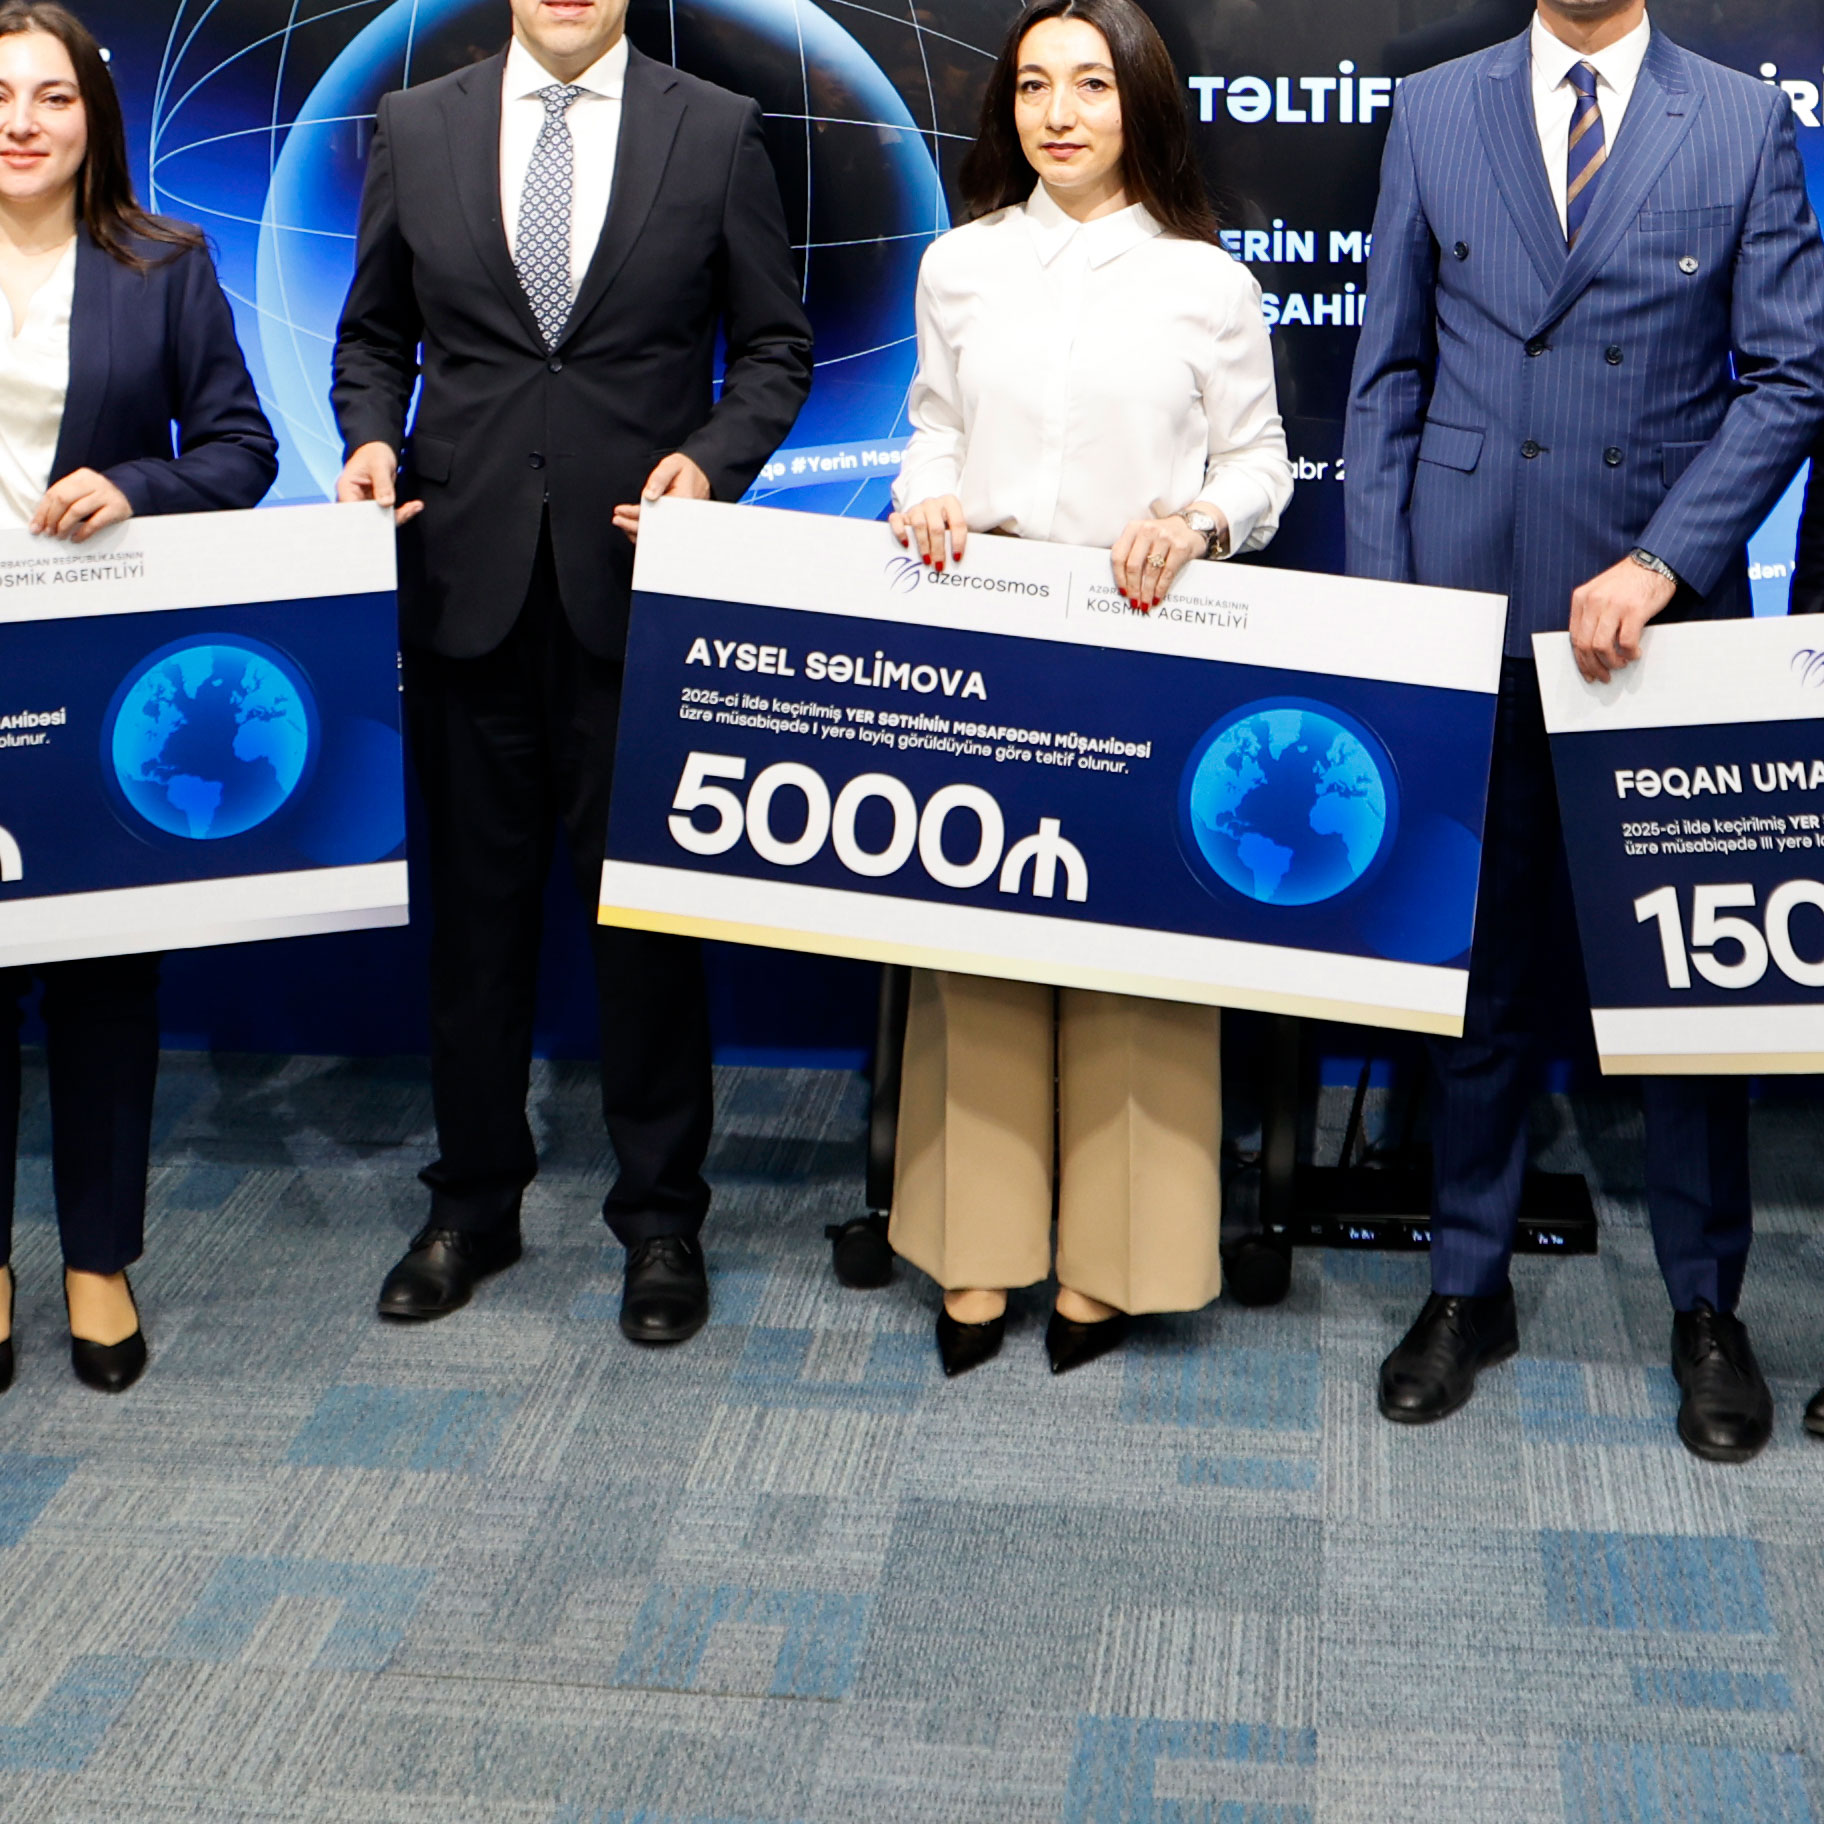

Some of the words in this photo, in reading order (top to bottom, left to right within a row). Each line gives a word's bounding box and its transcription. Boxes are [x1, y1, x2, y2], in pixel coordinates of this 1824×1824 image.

[1189, 60, 1402, 124] TƏLTİF
[1217, 219, 1314, 263] ERİN
[52, 562, 145, 584] AGENTLİYİ
[927, 570, 1050, 598] azercosmos
[1158, 607, 1248, 630] AGENTLİYİ
[684, 637, 796, 677] AYSEL
[804, 650, 988, 701] SƏLİMOVA
[680, 687, 740, 709] 2025-ci
[741, 694, 769, 712] ildə
[772, 698, 843, 722] keçirilmiş
[845, 707, 874, 725] YER
[877, 711, 950, 734] SƏTHİNİN
[679, 704, 713, 722] üzrə
[821, 725, 856, 745] yerə
[858, 726, 895, 748] layiq
[995, 744, 1032, 763] görə
[1077, 756, 1129, 775] olunur.
[1614, 764, 1743, 800] FƏQAN
[1622, 820, 1681, 837] 2025-ci
[1683, 818, 1711, 835] ildə
[1713, 816, 1787, 835] keçirilmiş
[1789, 814, 1820, 830] YER
[1625, 840, 1658, 856] üzrə
[1776, 836, 1813, 853] yerə
